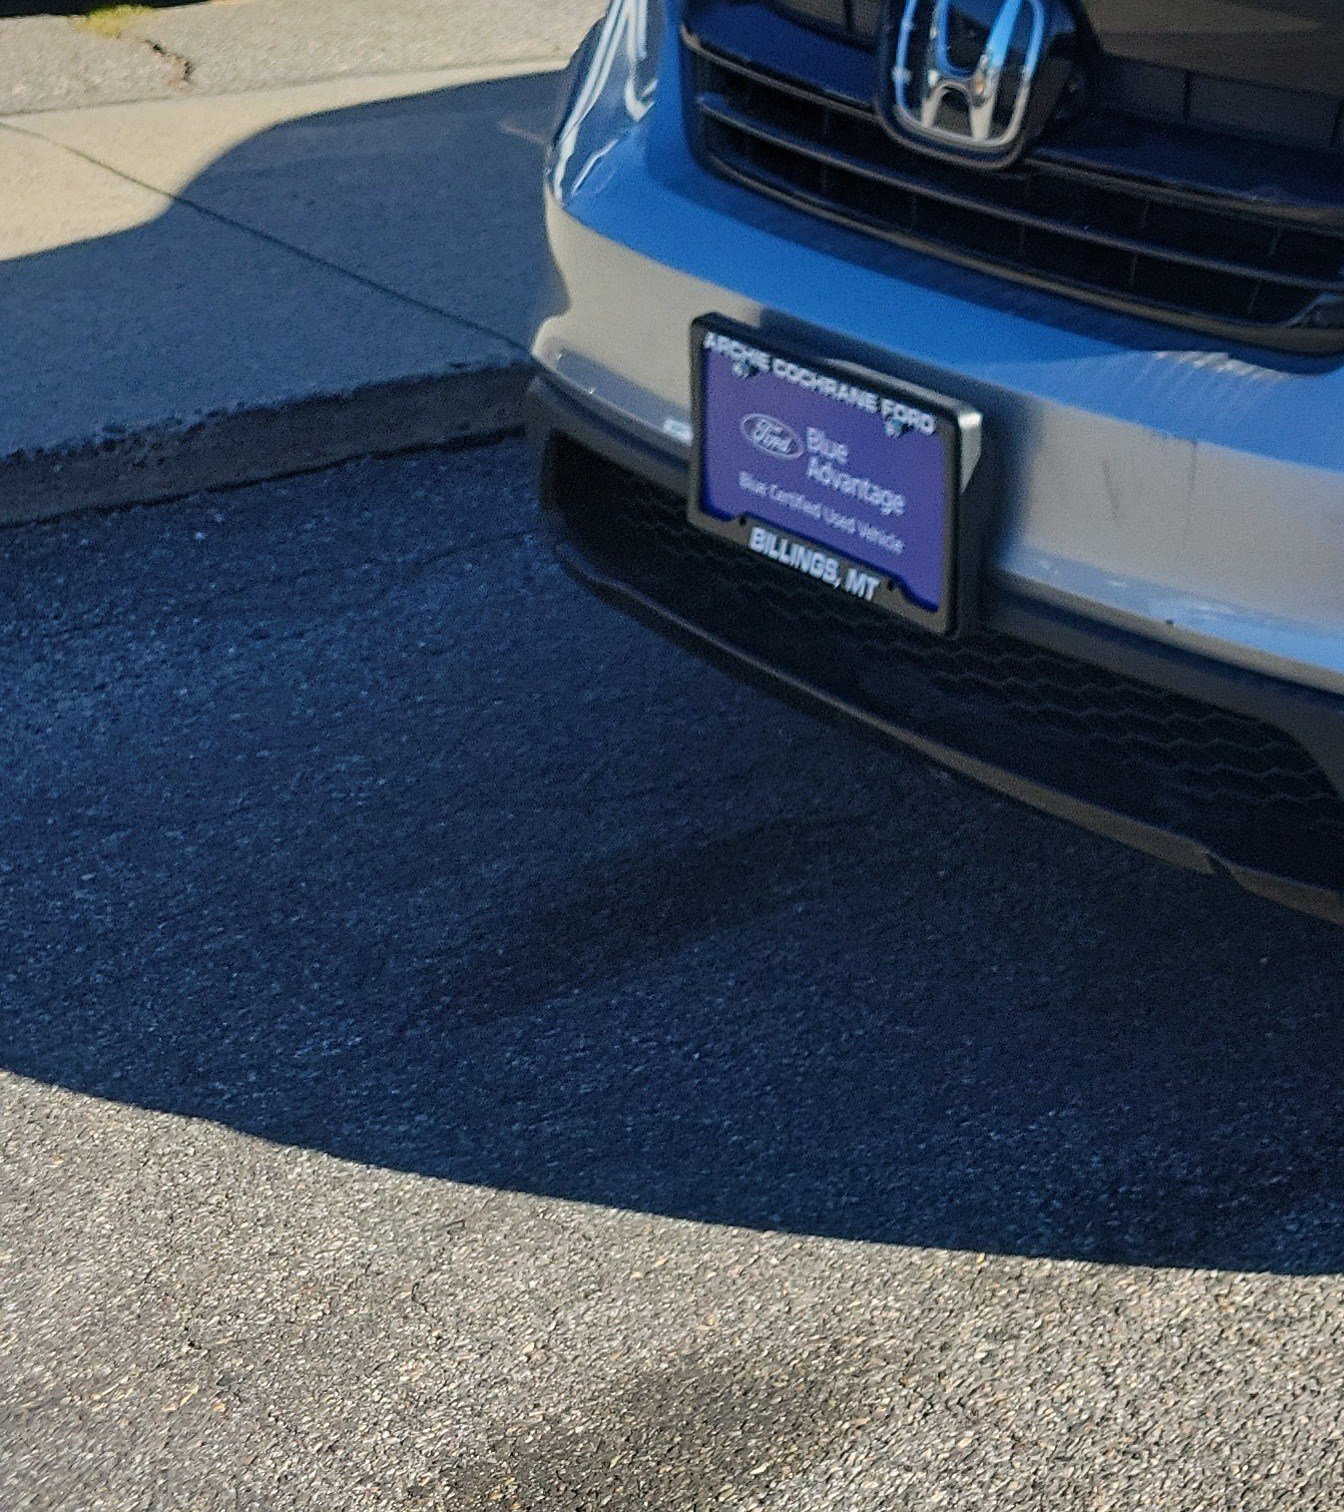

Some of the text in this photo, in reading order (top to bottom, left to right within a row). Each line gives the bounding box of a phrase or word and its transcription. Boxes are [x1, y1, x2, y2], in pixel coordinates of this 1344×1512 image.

[772, 358, 879, 414] COCHRANE
[881, 398, 936, 436] FORD
[806, 426, 849, 465] Blue
[806, 457, 906, 516] Advantage
[749, 526, 880, 601] BILLINGS, MT
